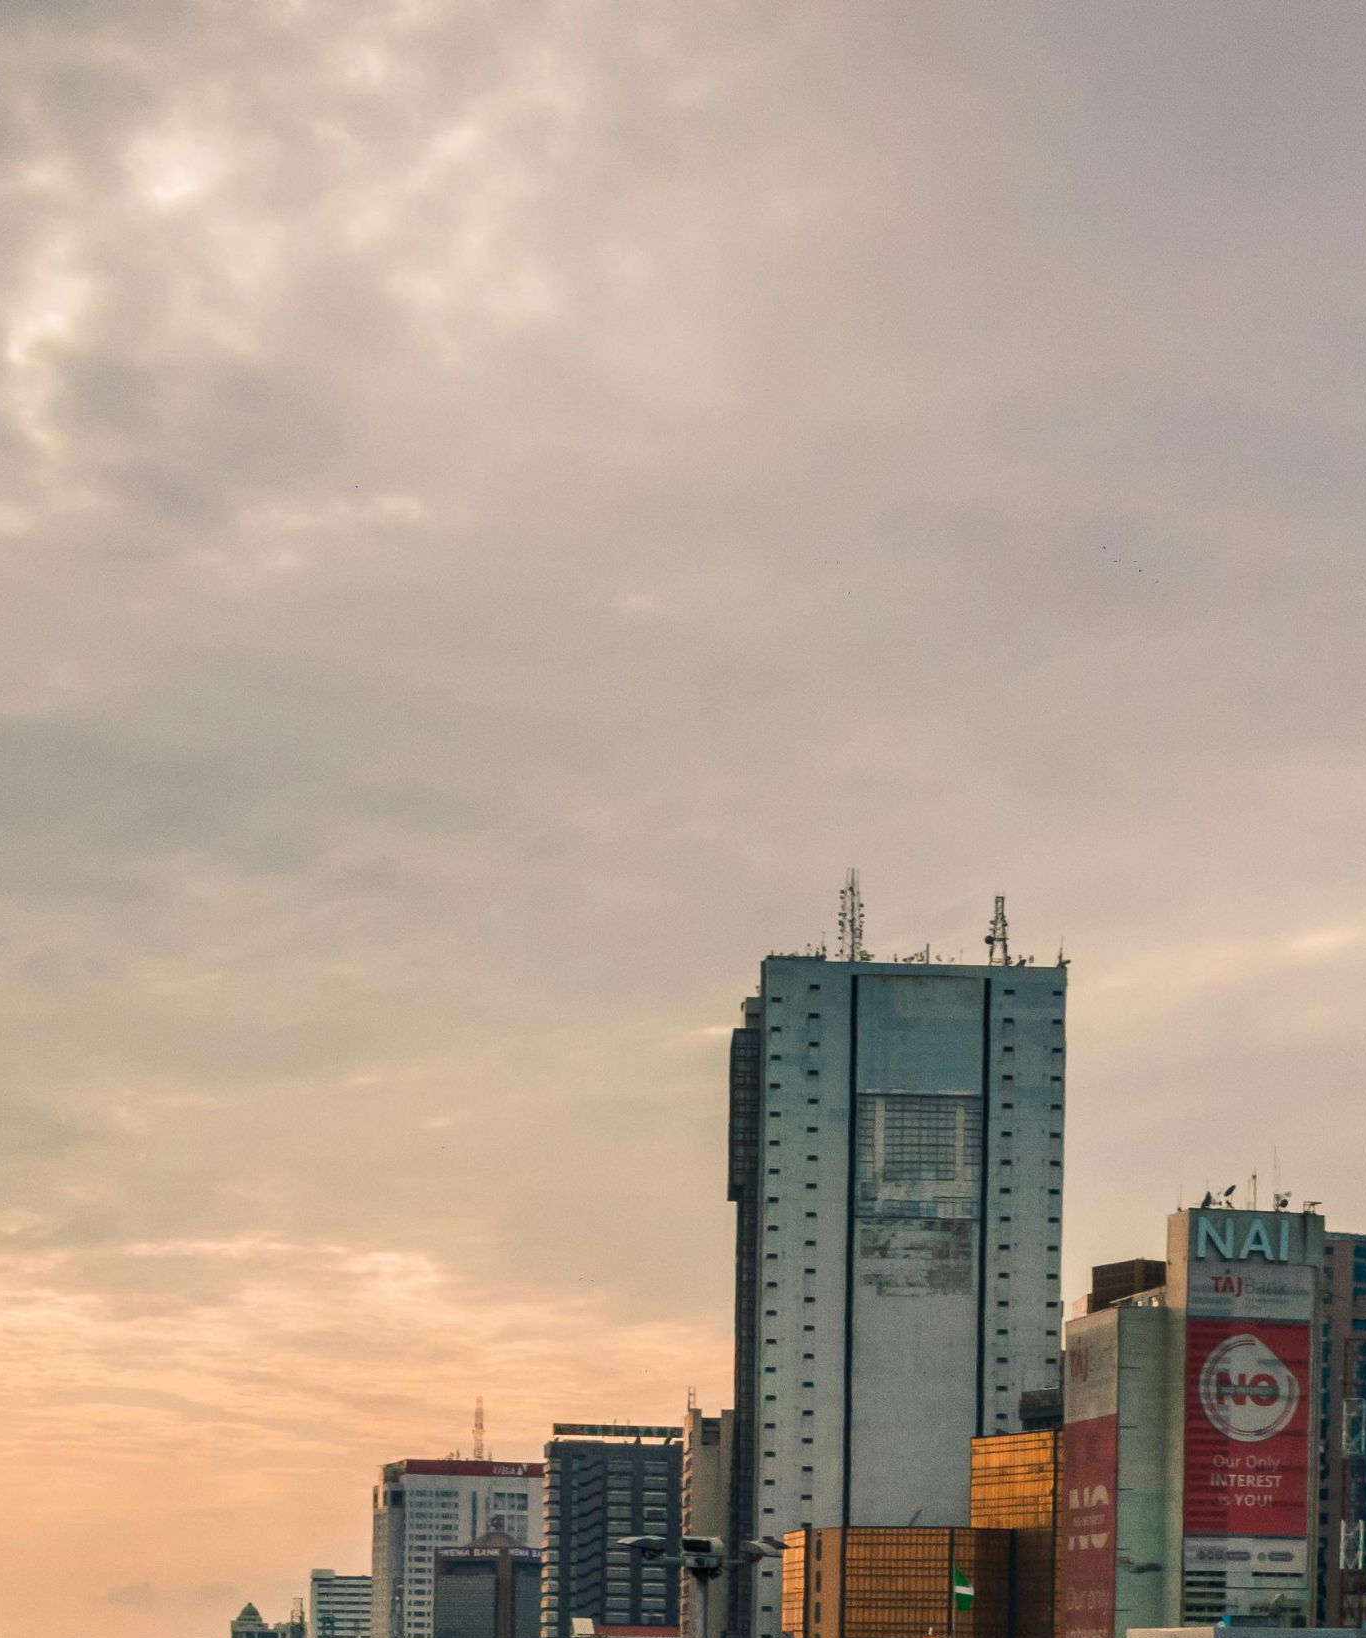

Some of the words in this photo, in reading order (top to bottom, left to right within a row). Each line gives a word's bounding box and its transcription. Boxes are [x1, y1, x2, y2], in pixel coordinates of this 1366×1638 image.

[1197, 1216, 1289, 1261] NAI
[1217, 1372, 1280, 1407] NO
[1213, 1454, 1240, 1468] Our
[1246, 1455, 1281, 1472] Only
[1210, 1474, 1282, 1488] INTEREST
[1235, 1494, 1273, 1508] YOU!
[474, 1548, 501, 1557] BANK
